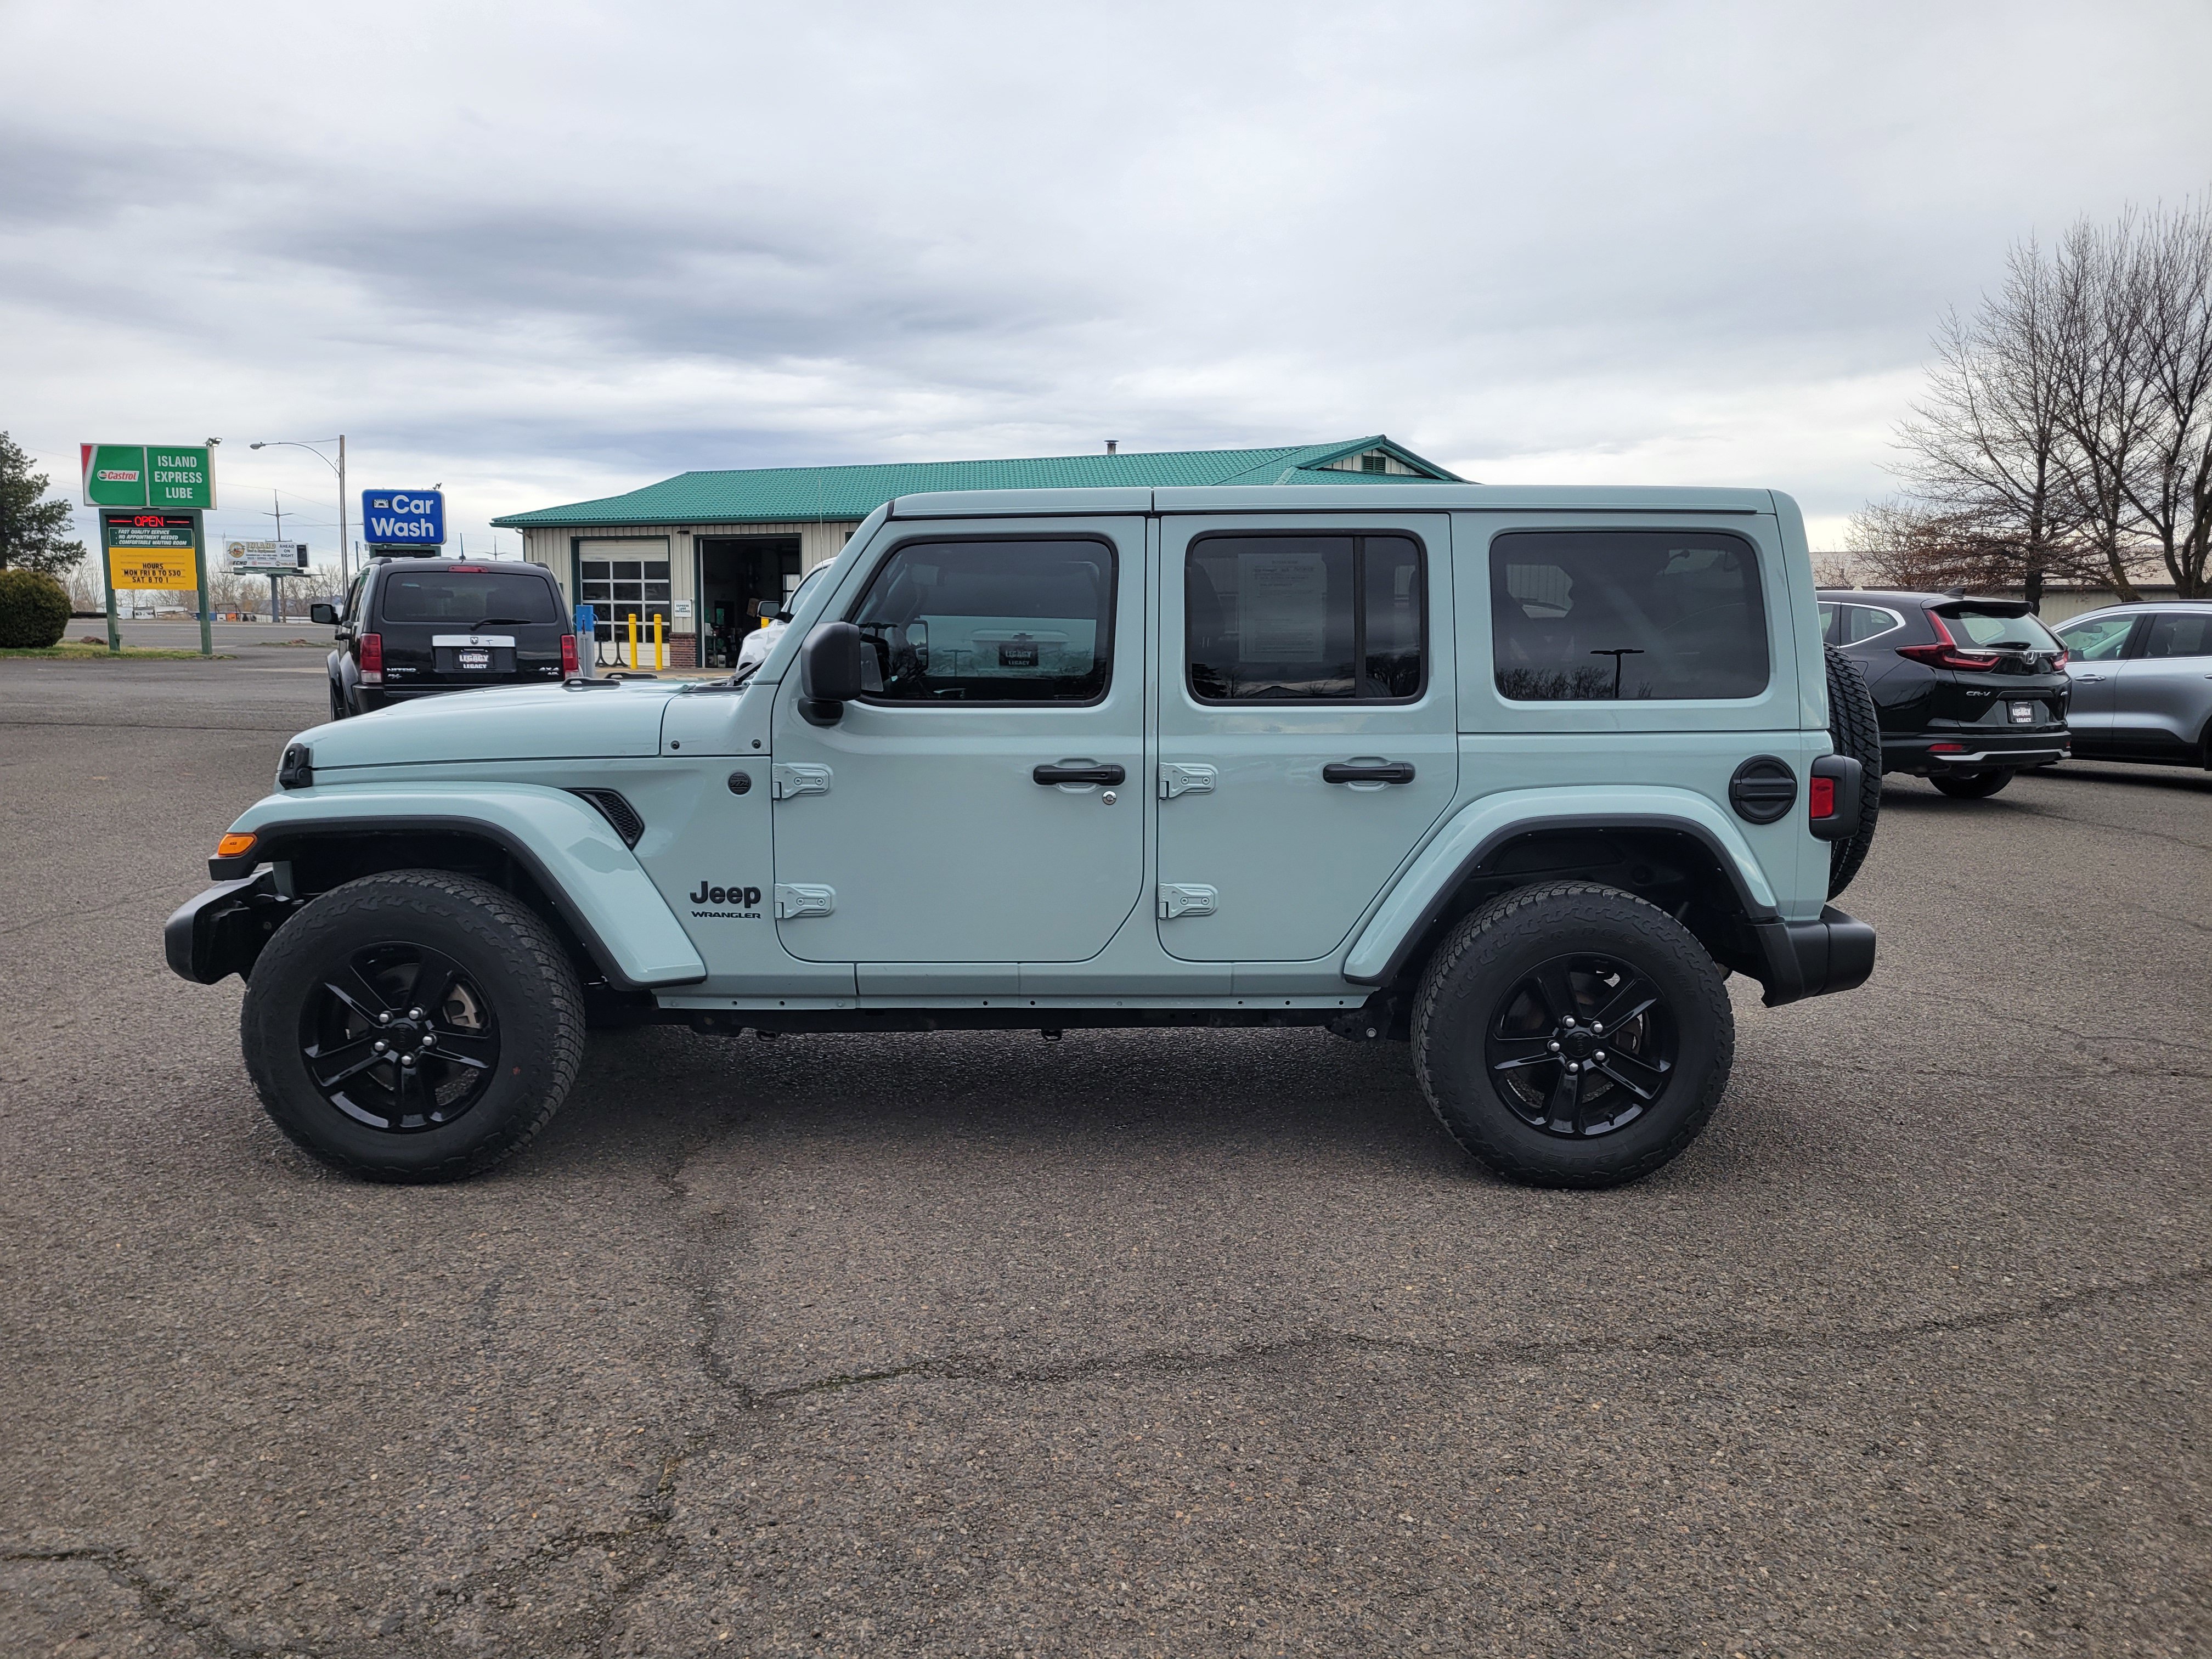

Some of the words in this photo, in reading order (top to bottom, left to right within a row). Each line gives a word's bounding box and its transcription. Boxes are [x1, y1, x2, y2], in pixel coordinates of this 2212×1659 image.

[157, 455, 197, 467] ISLAND
[108, 471, 137, 480] Castrol
[154, 471, 202, 483] EXPRESS
[166, 487, 193, 499] LUBE
[392, 495, 434, 514] Car
[134, 516, 164, 527] OPEN
[371, 517, 434, 537] Wash
[690, 881, 761, 909] Jeep
[1527, 925, 1700, 1002] BRIDGESTONE
